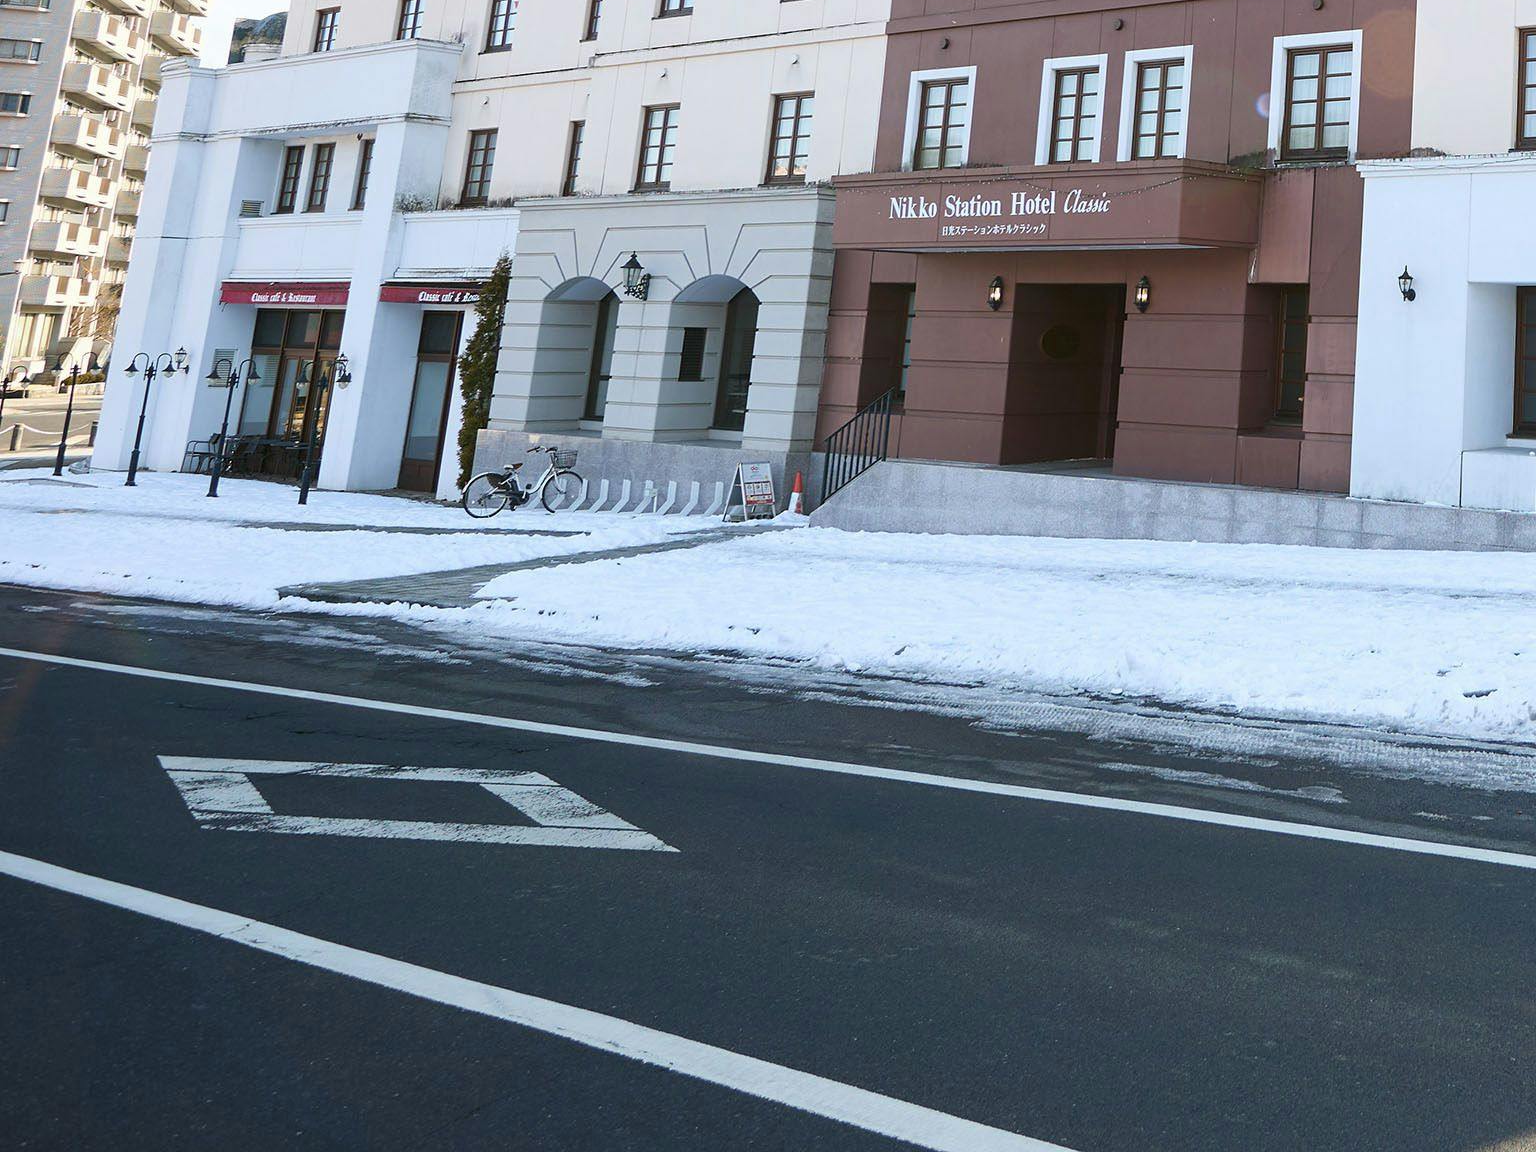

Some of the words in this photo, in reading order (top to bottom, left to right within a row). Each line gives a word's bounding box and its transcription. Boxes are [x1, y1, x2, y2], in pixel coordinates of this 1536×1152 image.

[889, 196, 938, 219] Nikko
[944, 194, 1002, 218] Station
[1010, 190, 1056, 216] Hotel
[1063, 188, 1111, 214] Classic
[942, 223, 1047, 236] 日光ステーションホテルクラシック
